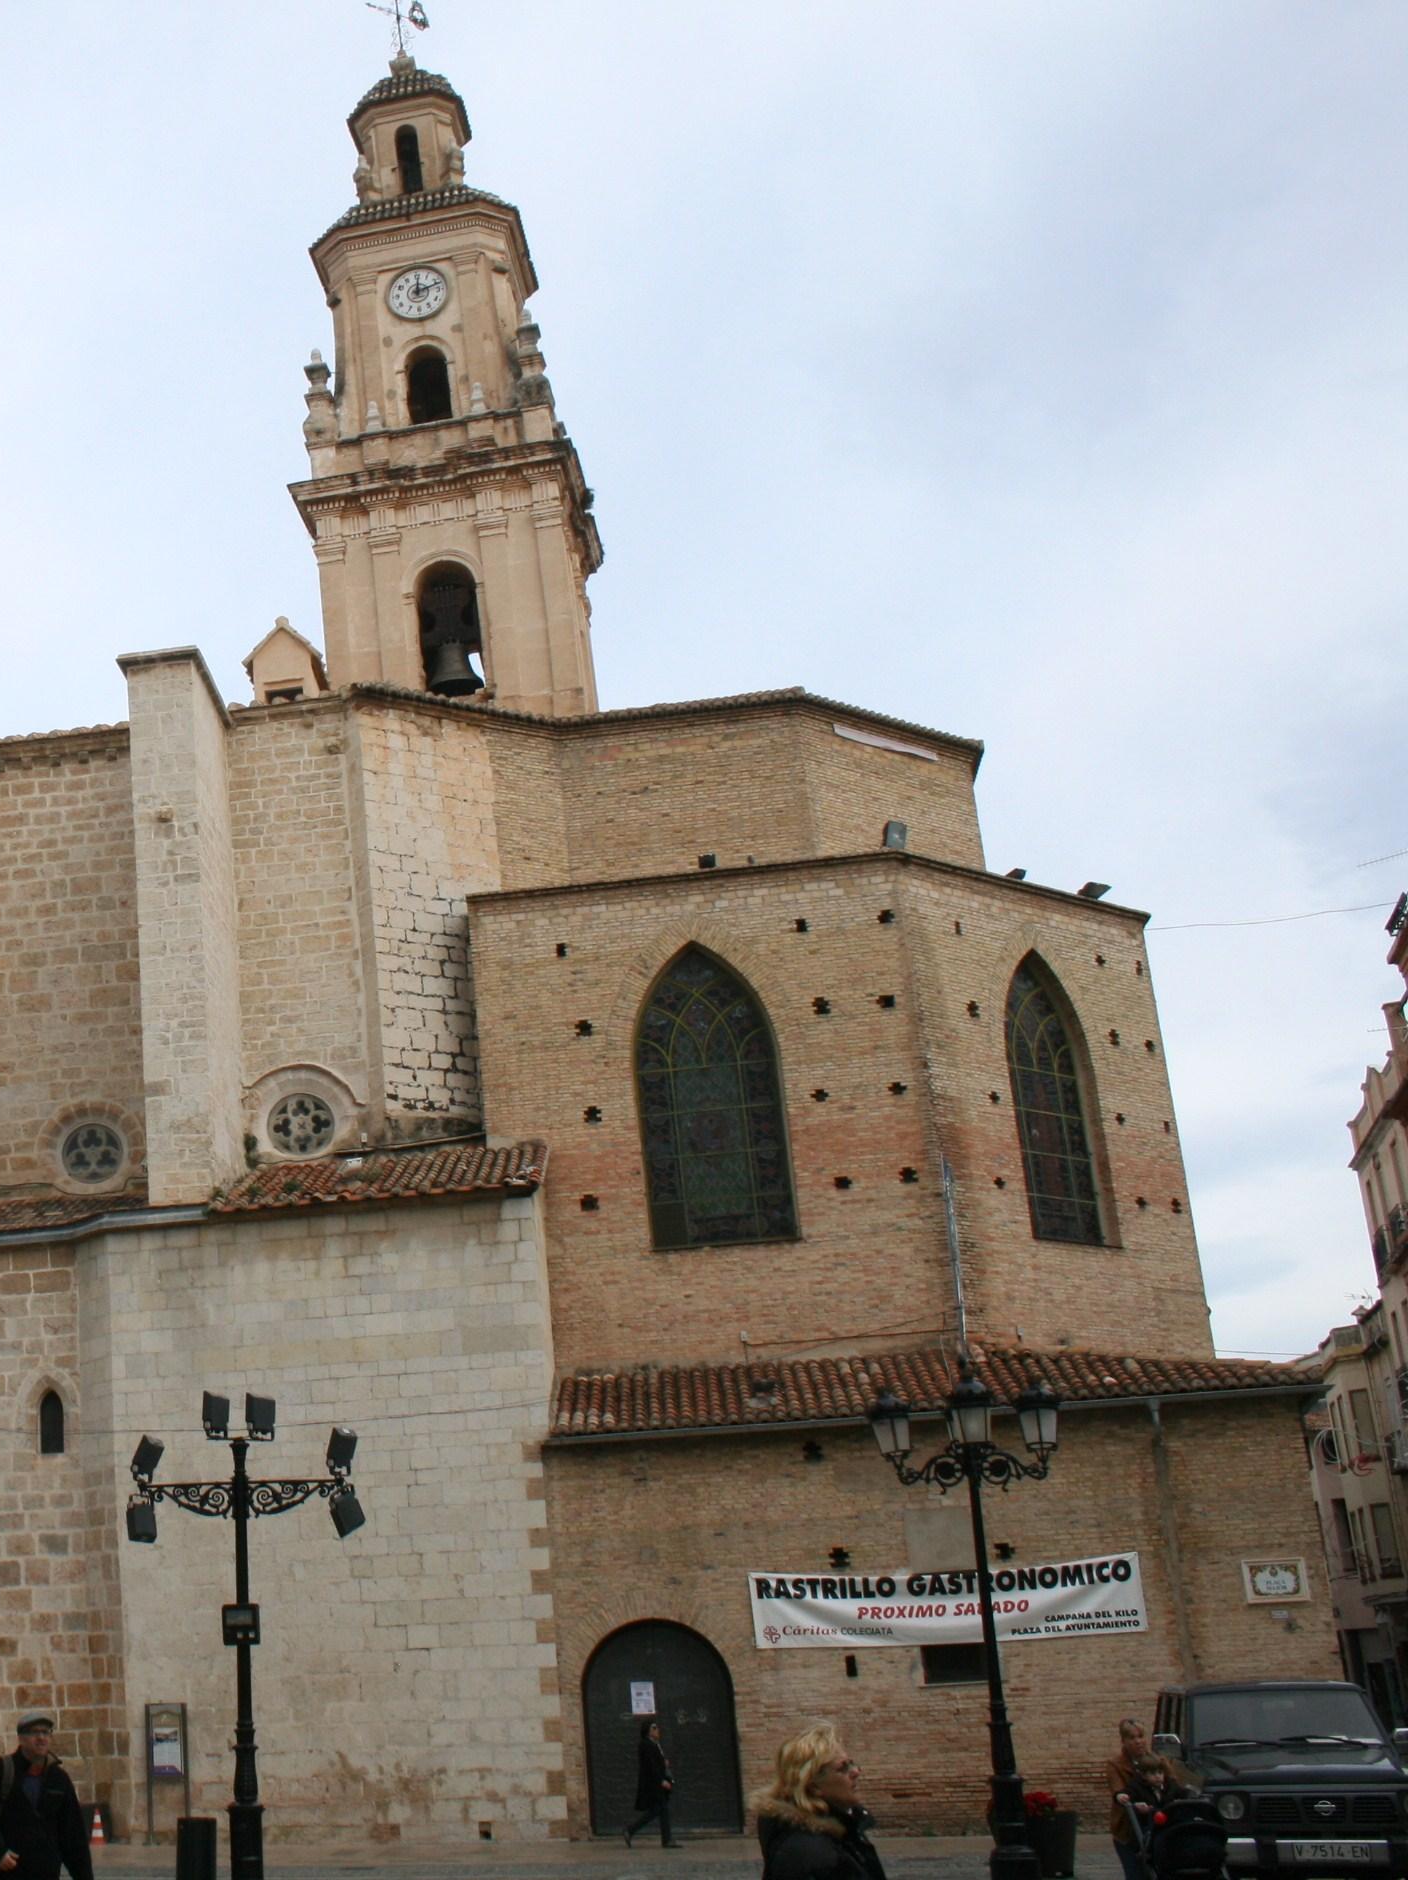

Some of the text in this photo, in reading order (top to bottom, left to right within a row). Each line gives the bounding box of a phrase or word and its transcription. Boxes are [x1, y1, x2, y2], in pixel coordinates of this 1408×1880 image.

[756, 1576, 896, 1599] RASTRILLO
[857, 1604, 947, 1620] PROXIMO
[1094, 1610, 1112, 1619] DEL
[1114, 1608, 1138, 1617] KILO
[782, 1624, 893, 1636] Cáritas COLEGIATA
[1011, 1619, 1140, 1636] PLAZA DEL AYUNTAMIENTO
